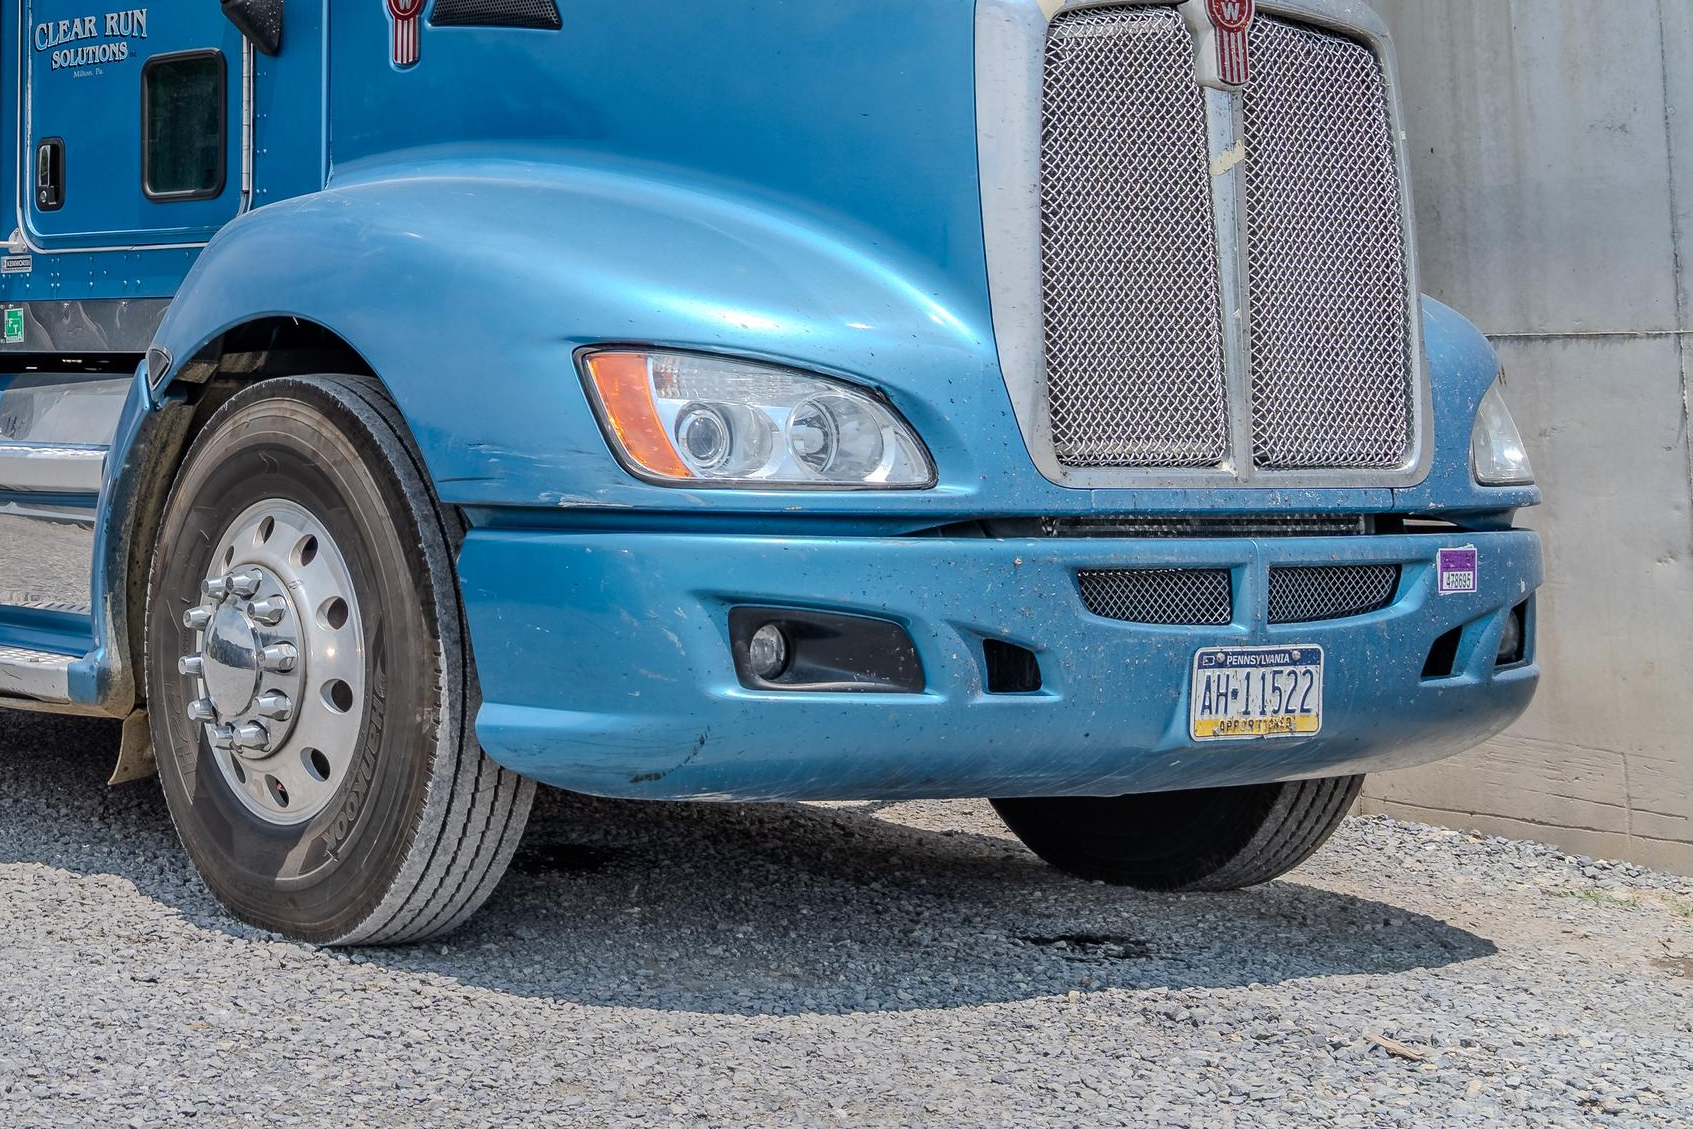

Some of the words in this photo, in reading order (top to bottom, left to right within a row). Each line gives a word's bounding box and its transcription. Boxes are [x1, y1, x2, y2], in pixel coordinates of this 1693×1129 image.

[34, 16, 98, 51] CLEAR
[105, 8, 148, 38] RUN
[52, 41, 128, 70] SOLUTIONS
[1227, 654, 1289, 665] PENNSYLVANIA
